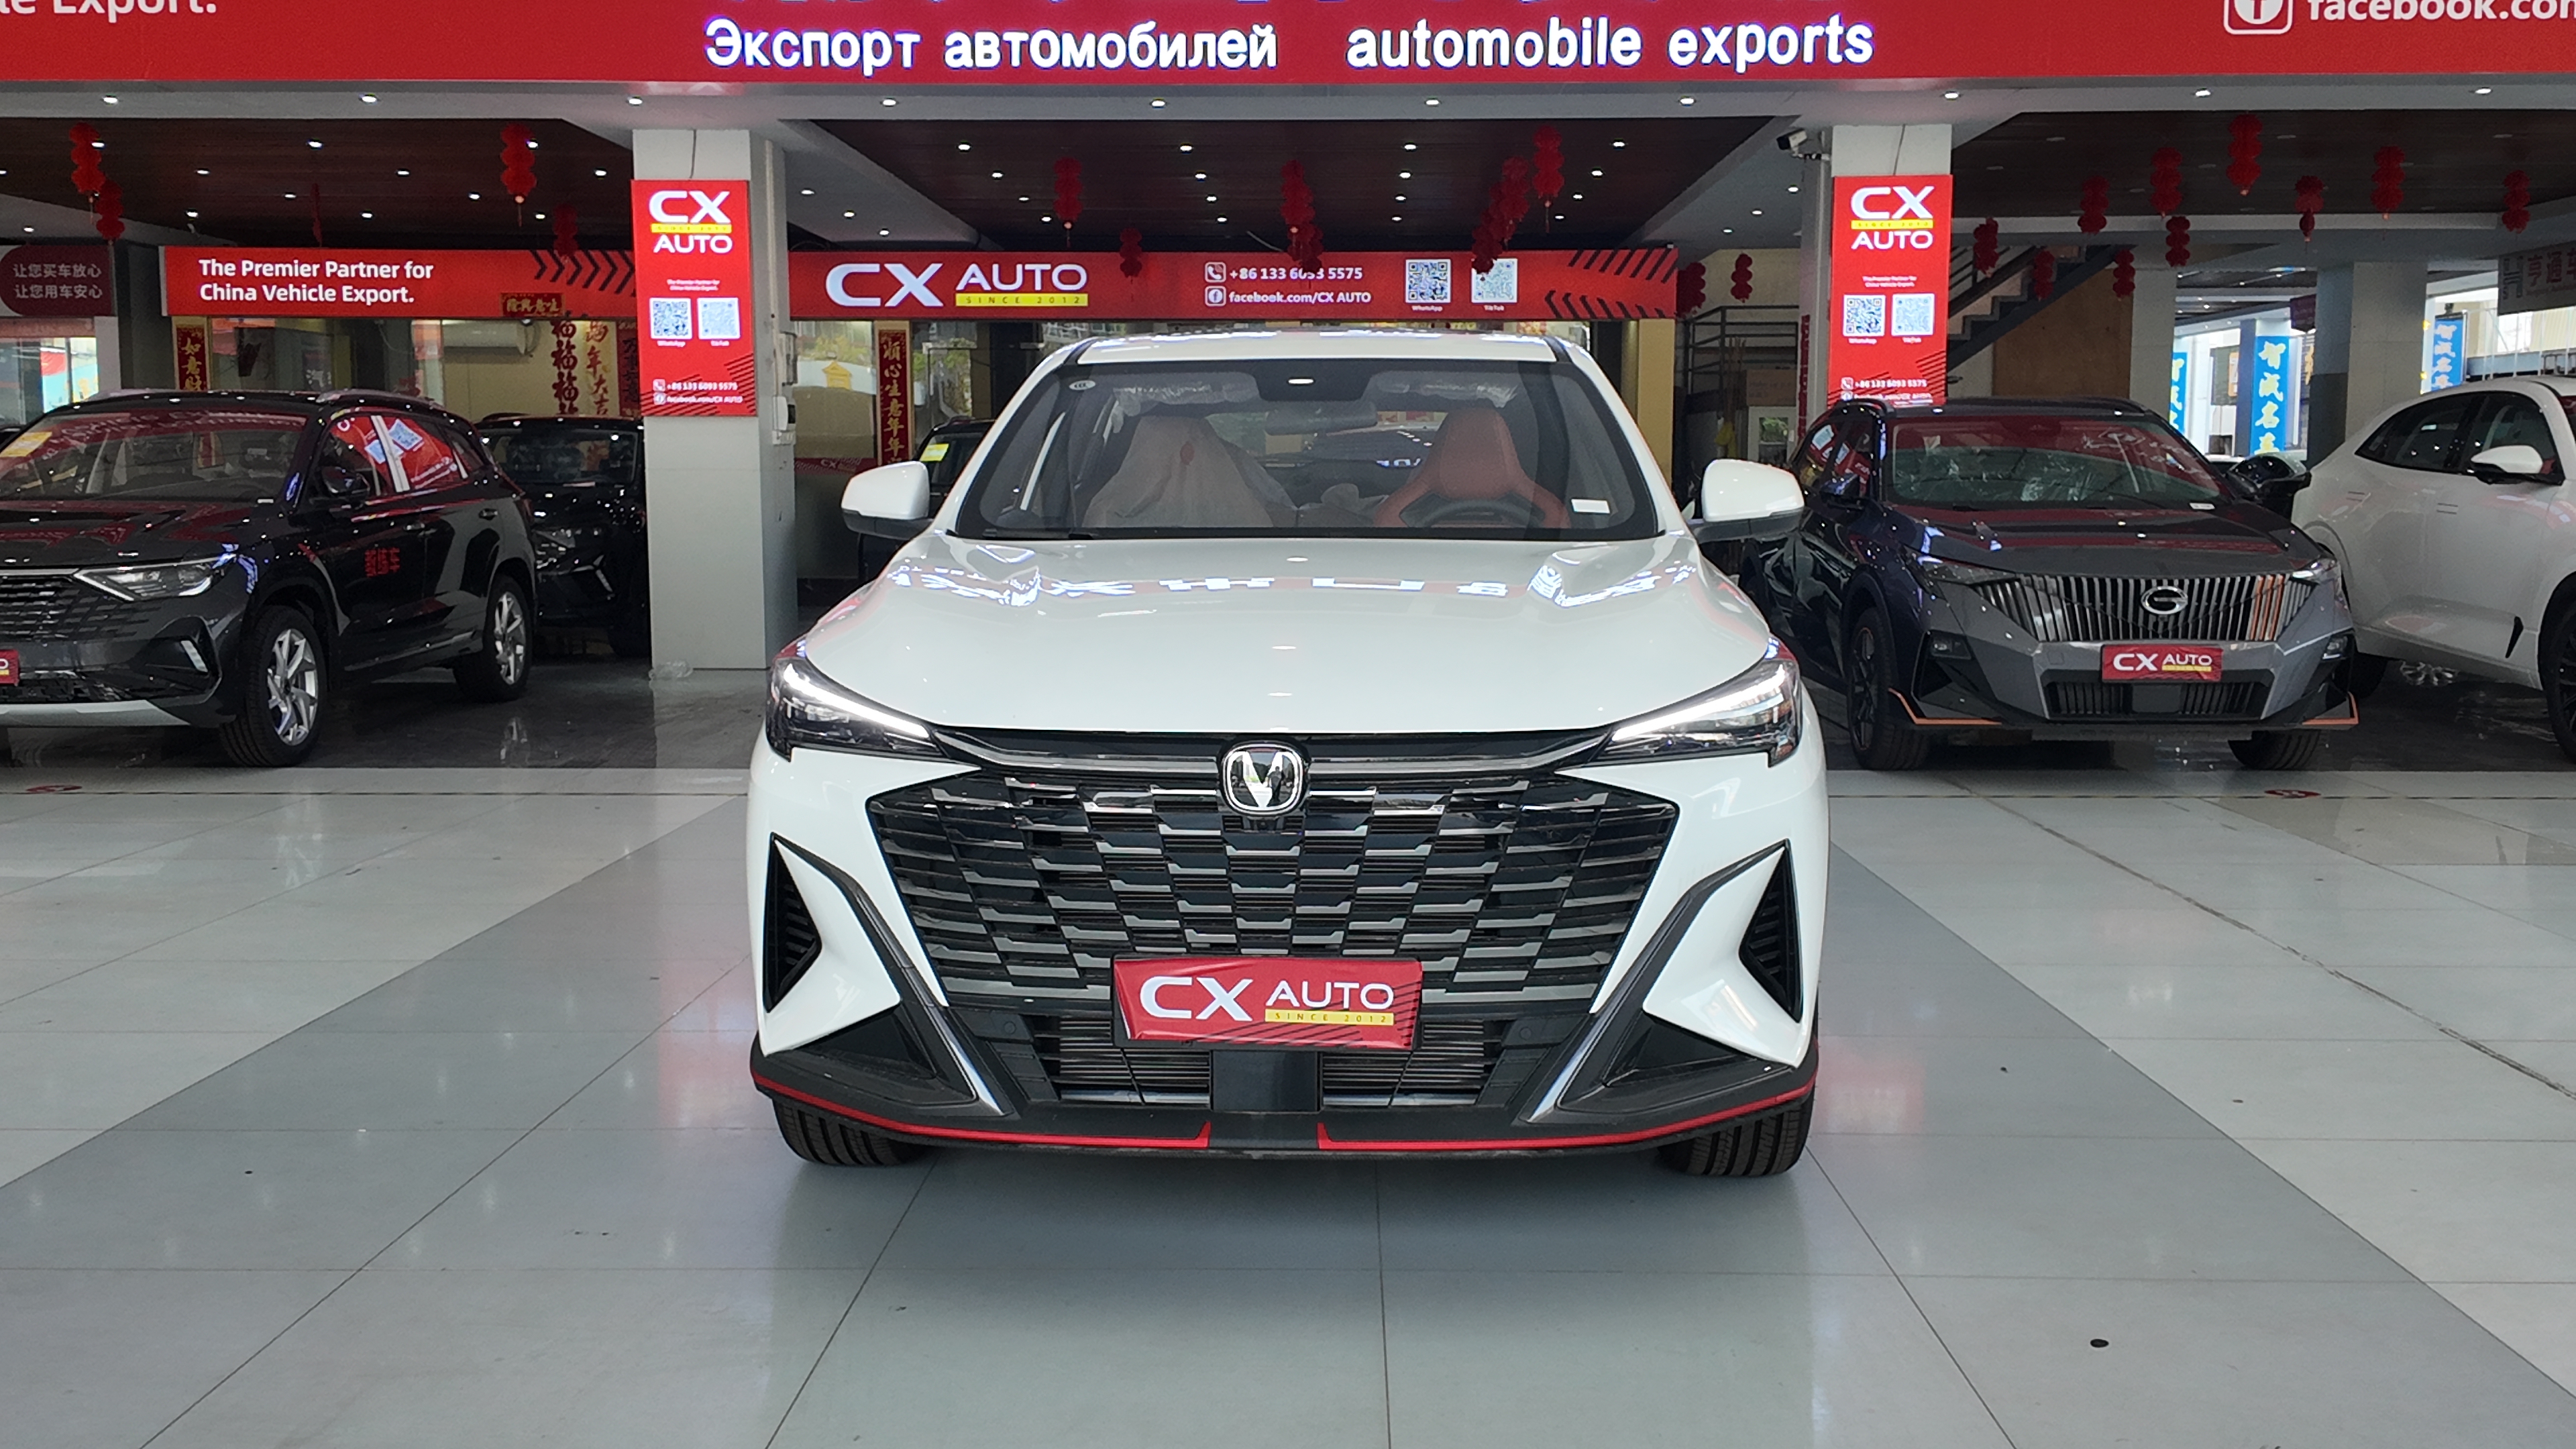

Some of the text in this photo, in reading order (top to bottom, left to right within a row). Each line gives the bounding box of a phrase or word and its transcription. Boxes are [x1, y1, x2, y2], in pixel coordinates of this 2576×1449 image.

[704, 18, 1278, 76] Экспорт автомобилей
[1346, 14, 1875, 73] automobile exports
[649, 190, 731, 223] CX
[1851, 186, 1935, 219] CX
[653, 234, 733, 254] AUTO
[1851, 230, 1933, 250] AUTO
[13, 263, 103, 278] 让您买车放心
[199, 259, 434, 279] The Premier Partner for
[1230, 268, 1258, 280] +86
[1260, 268, 1287, 280] 133
[1328, 267, 1363, 280] 5575
[13, 284, 103, 299] 让您用车安心
[200, 283, 415, 306] China Vehicle Export.
[825, 262, 1088, 307] CX AUTO
[965, 296, 1081, 305] SINCE 2012
[1229, 292, 1372, 305] facebook.com/CX AUTO
[2113, 653, 2159, 672] CX
[2162, 653, 2212, 666] AUTO
[1140, 975, 1395, 1022] CX AUTO
[1275, 1012, 1387, 1023] SINCE 2012
